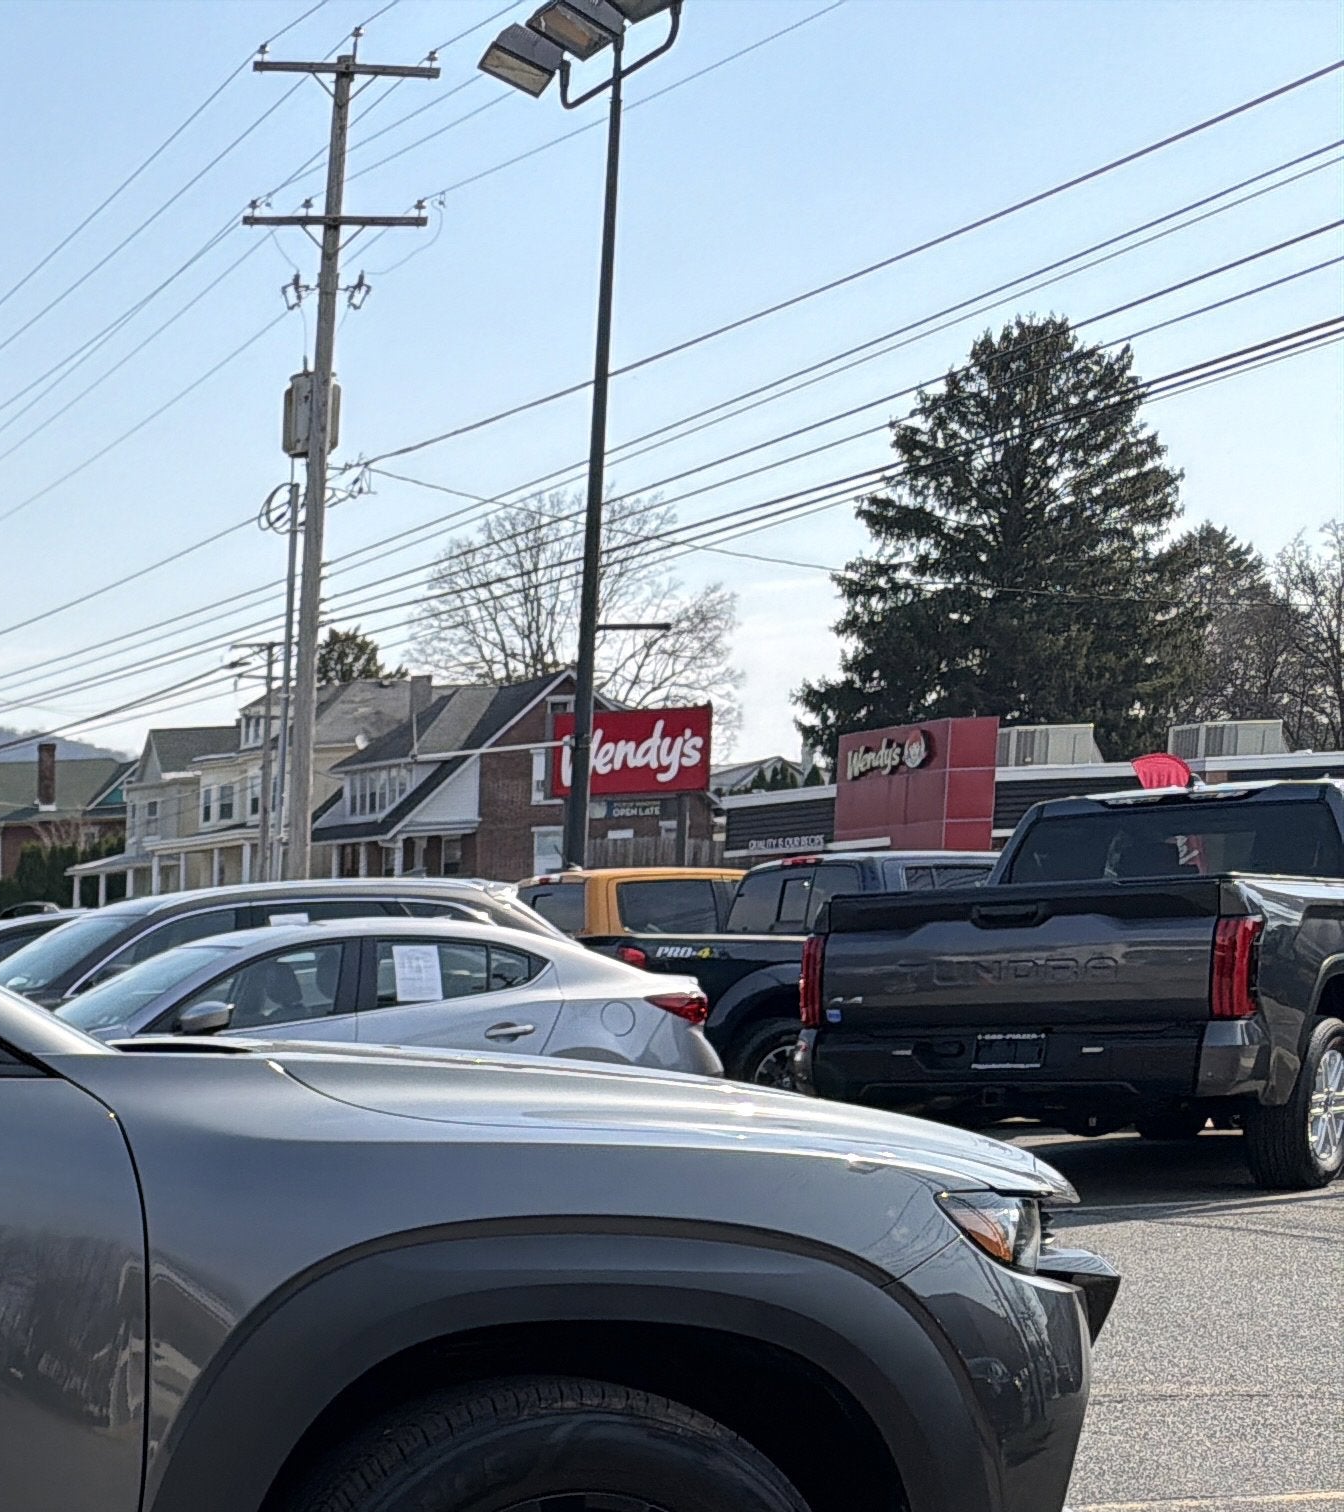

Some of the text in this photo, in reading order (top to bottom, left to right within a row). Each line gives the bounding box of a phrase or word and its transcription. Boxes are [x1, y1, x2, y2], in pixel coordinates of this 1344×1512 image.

[846, 737, 902, 781] Wendy's
[612, 807, 637, 817] OPEN
[898, 956, 1119, 988] TUNDRA
